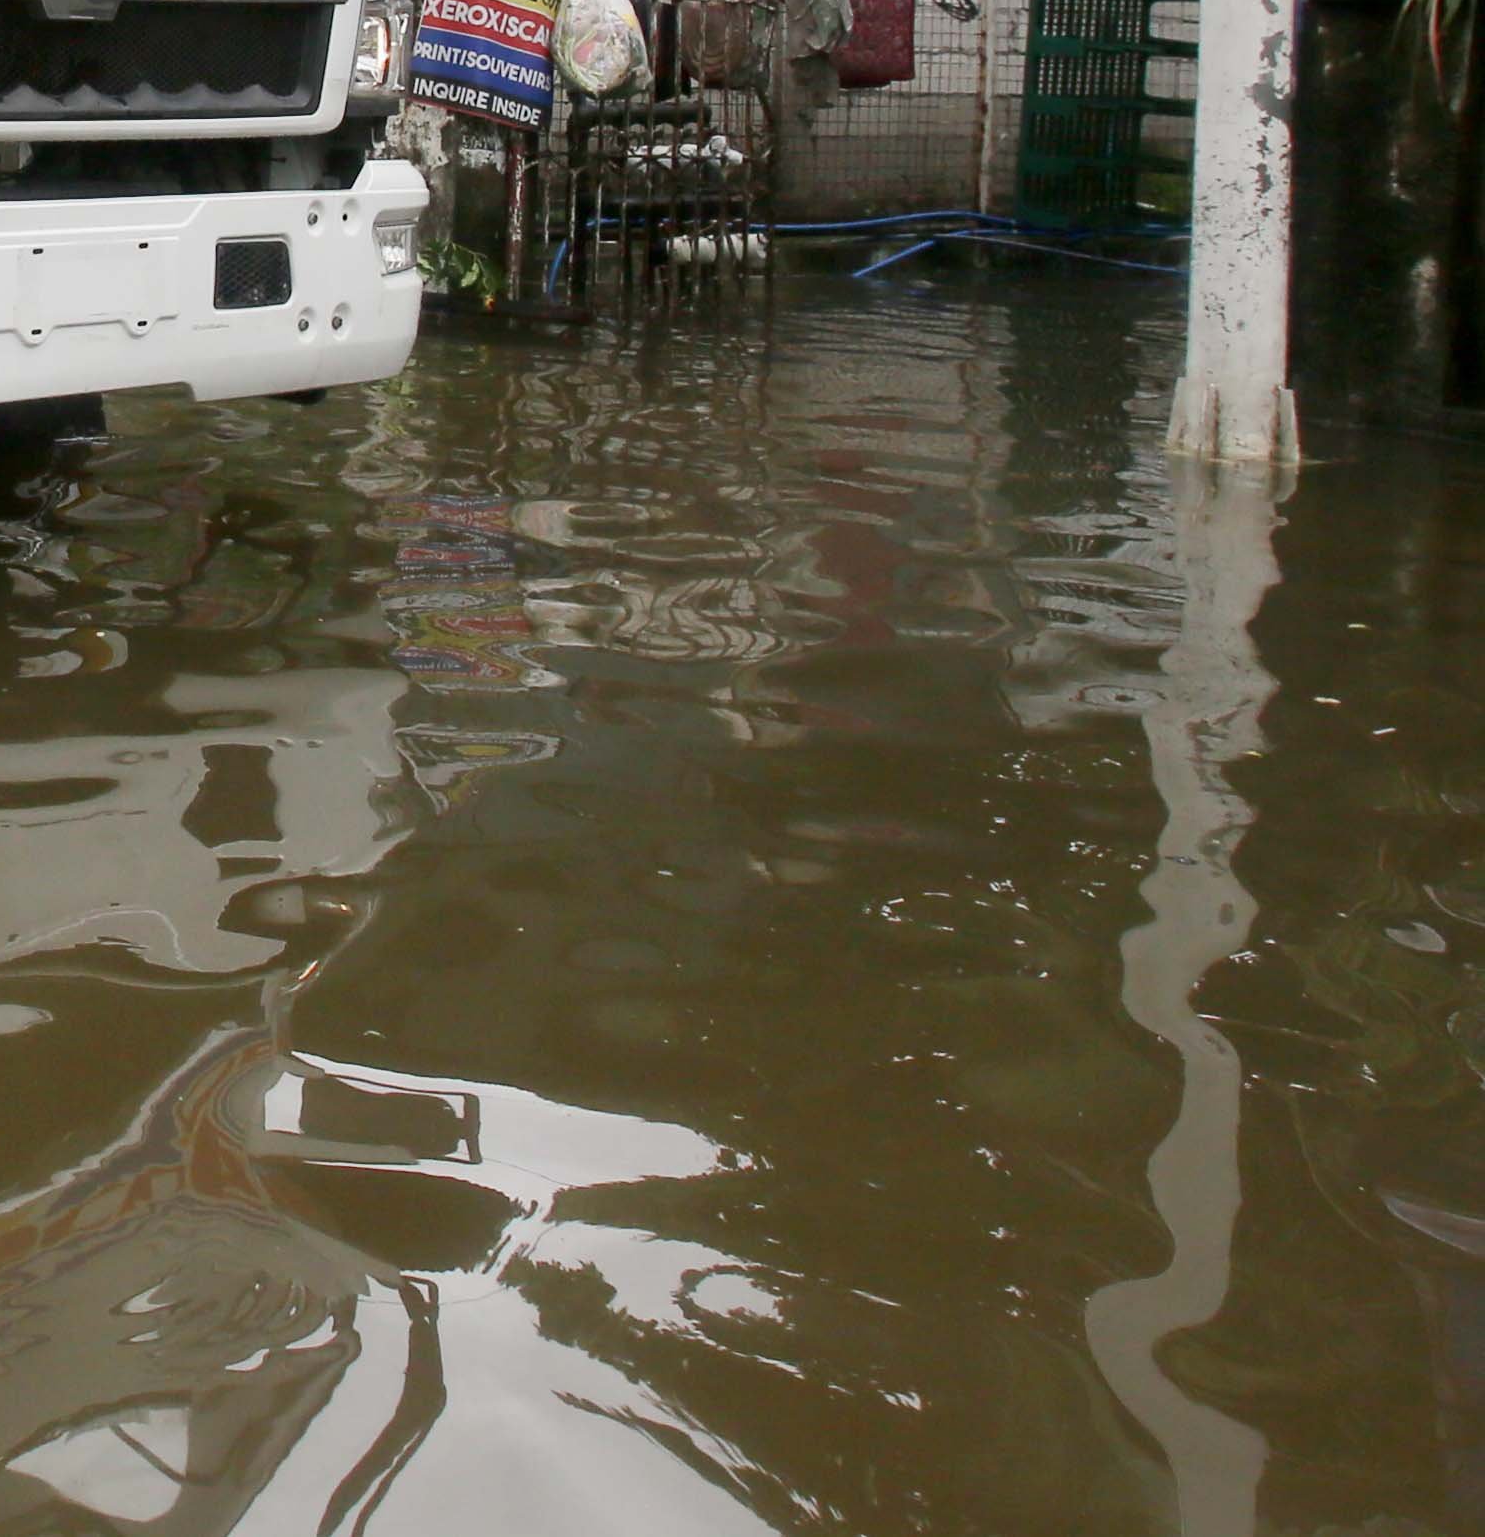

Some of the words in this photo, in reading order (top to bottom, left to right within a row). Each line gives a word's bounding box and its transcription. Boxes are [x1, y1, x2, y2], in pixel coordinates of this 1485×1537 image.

[413, 41, 551, 91] PRINT/SOUVENIRS
[413, 77, 490, 110] INQUIRE
[492, 96, 542, 126] INSIDE
